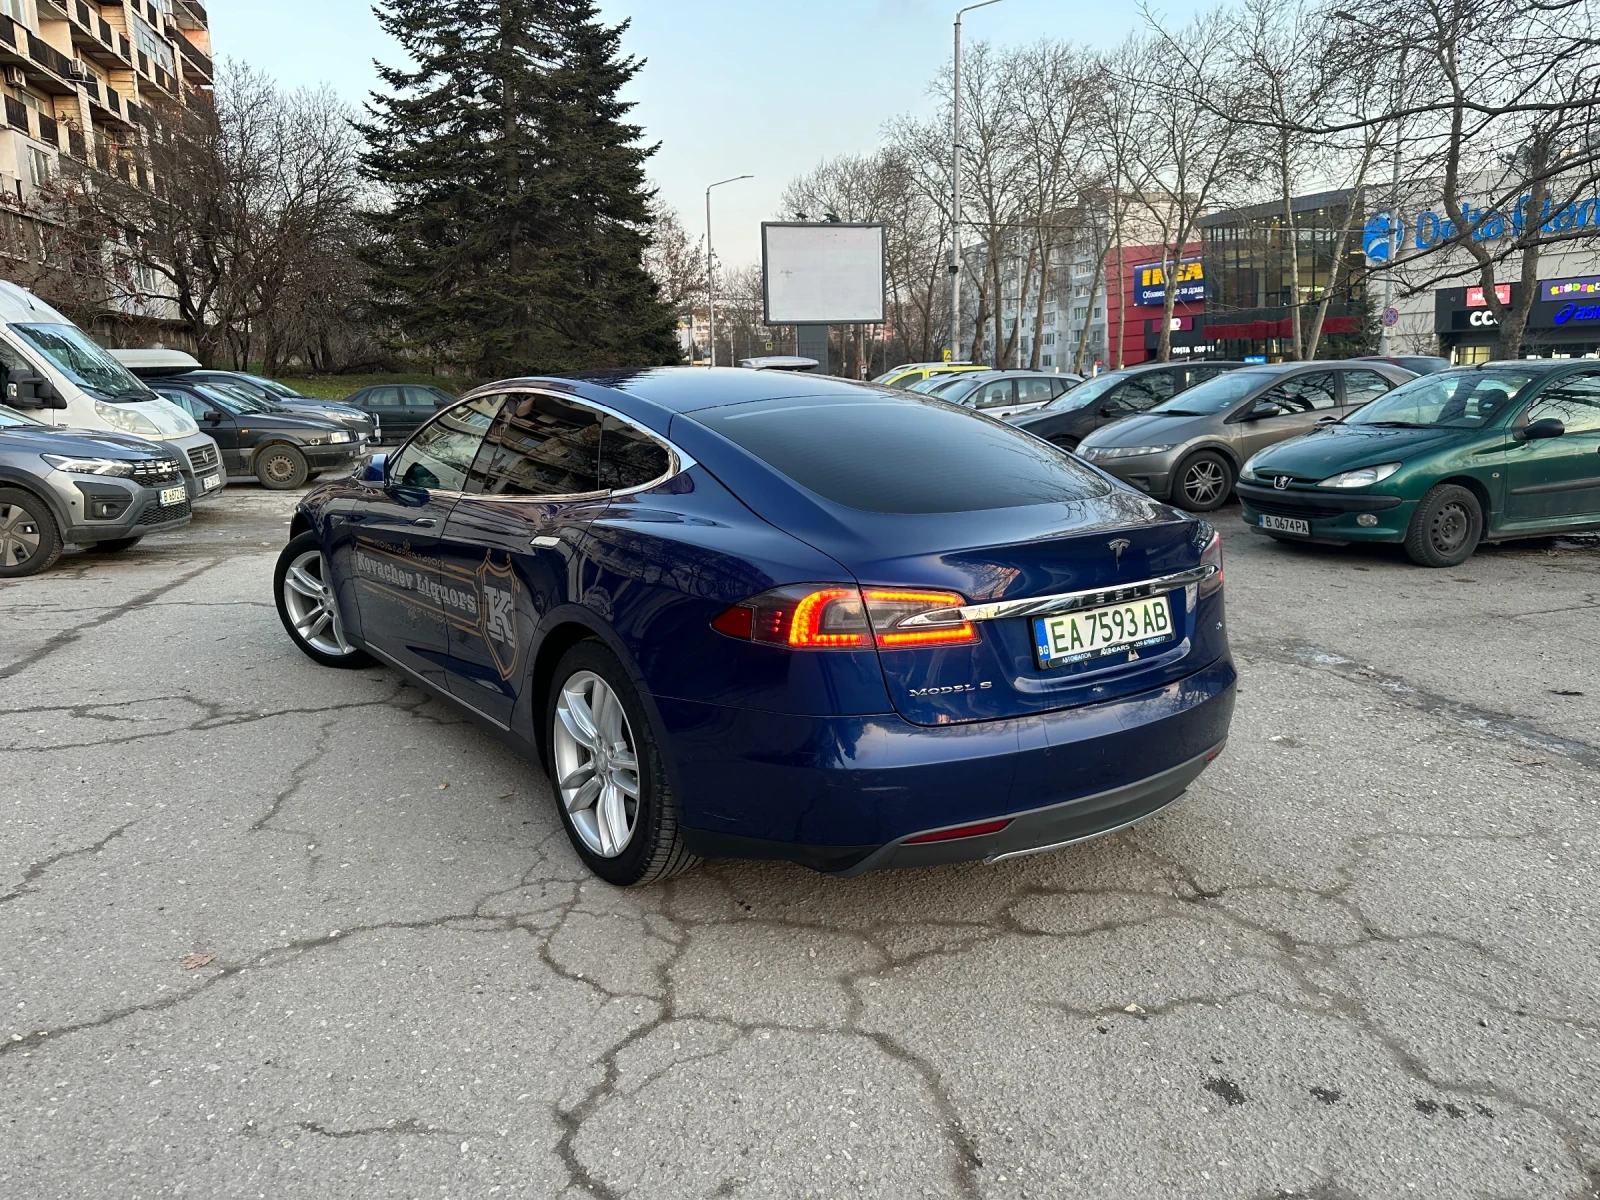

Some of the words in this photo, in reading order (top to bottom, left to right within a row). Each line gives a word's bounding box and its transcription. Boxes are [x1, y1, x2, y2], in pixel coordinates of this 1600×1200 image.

[1470, 311, 1498, 326] CC
[1265, 516, 1272, 527] B
[1274, 517, 1308, 533] 0674PA
[357, 551, 414, 589] Kovachev
[416, 572, 477, 614] Liquors
[1074, 583, 1157, 607] TESLA
[484, 584, 516, 649] K
[1038, 645, 1049, 656] BG
[909, 684, 975, 696] MODEL
[979, 681, 993, 689] S
